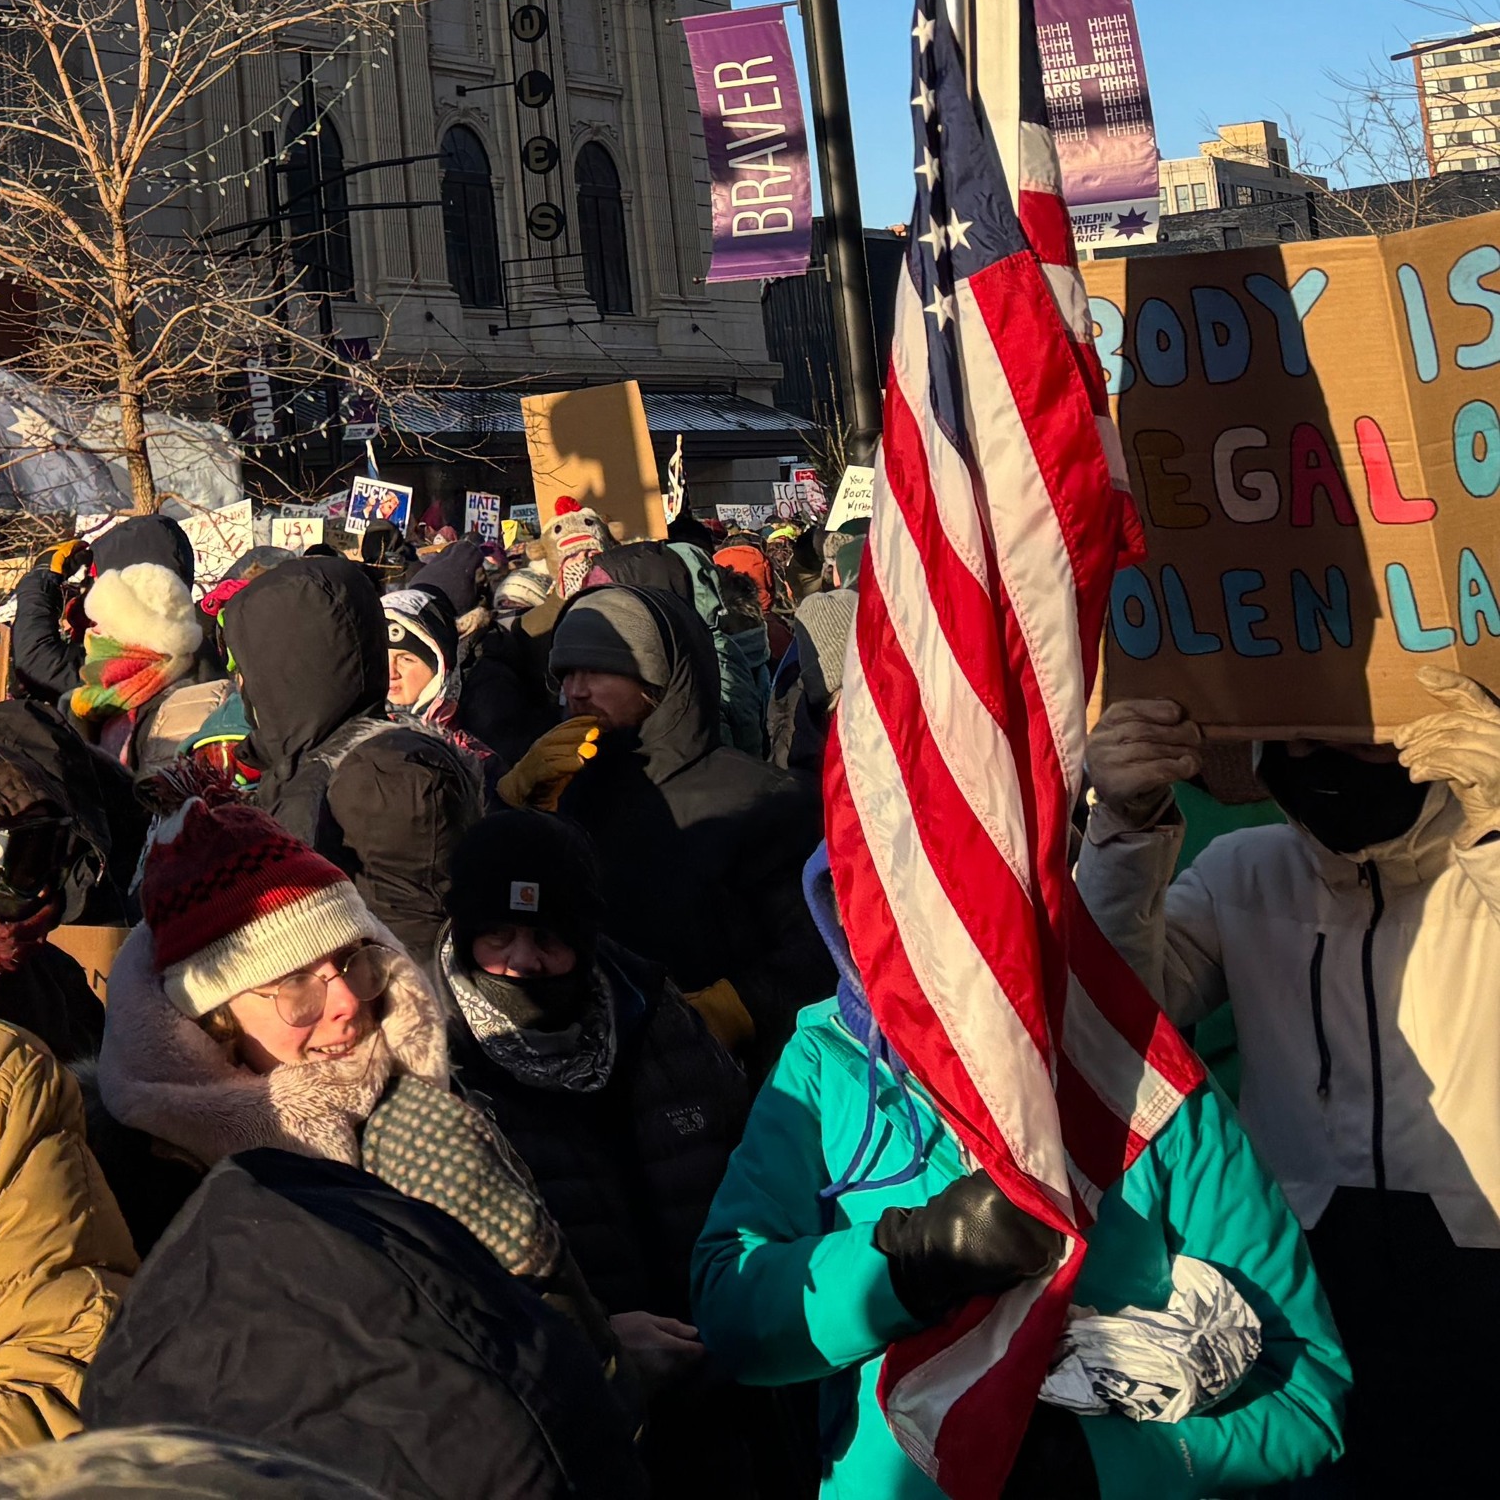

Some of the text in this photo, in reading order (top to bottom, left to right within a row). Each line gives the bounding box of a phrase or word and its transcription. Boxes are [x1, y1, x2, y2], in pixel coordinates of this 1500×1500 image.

[1042, 60, 1116, 84] HENNEPIN
[1043, 81, 1082, 99] ARTS
[712, 54, 794, 238] BRAVER
[1070, 211, 1113, 225] NNEPIN
[1073, 223, 1106, 235] ATRE
[1076, 233, 1105, 243] RICT
[1396, 244, 1500, 384] IS
[246, 358, 275, 438] BOLDER
[1132, 399, 1500, 529] EGAL O
[354, 482, 389, 501] FUCK
[774, 483, 807, 501] ICE
[469, 494, 499, 512] HATE
[478, 509, 489, 523] IS
[283, 521, 314, 537] USA
[471, 520, 494, 535] NOT
[1109, 546, 1500, 660] OLEN LA
